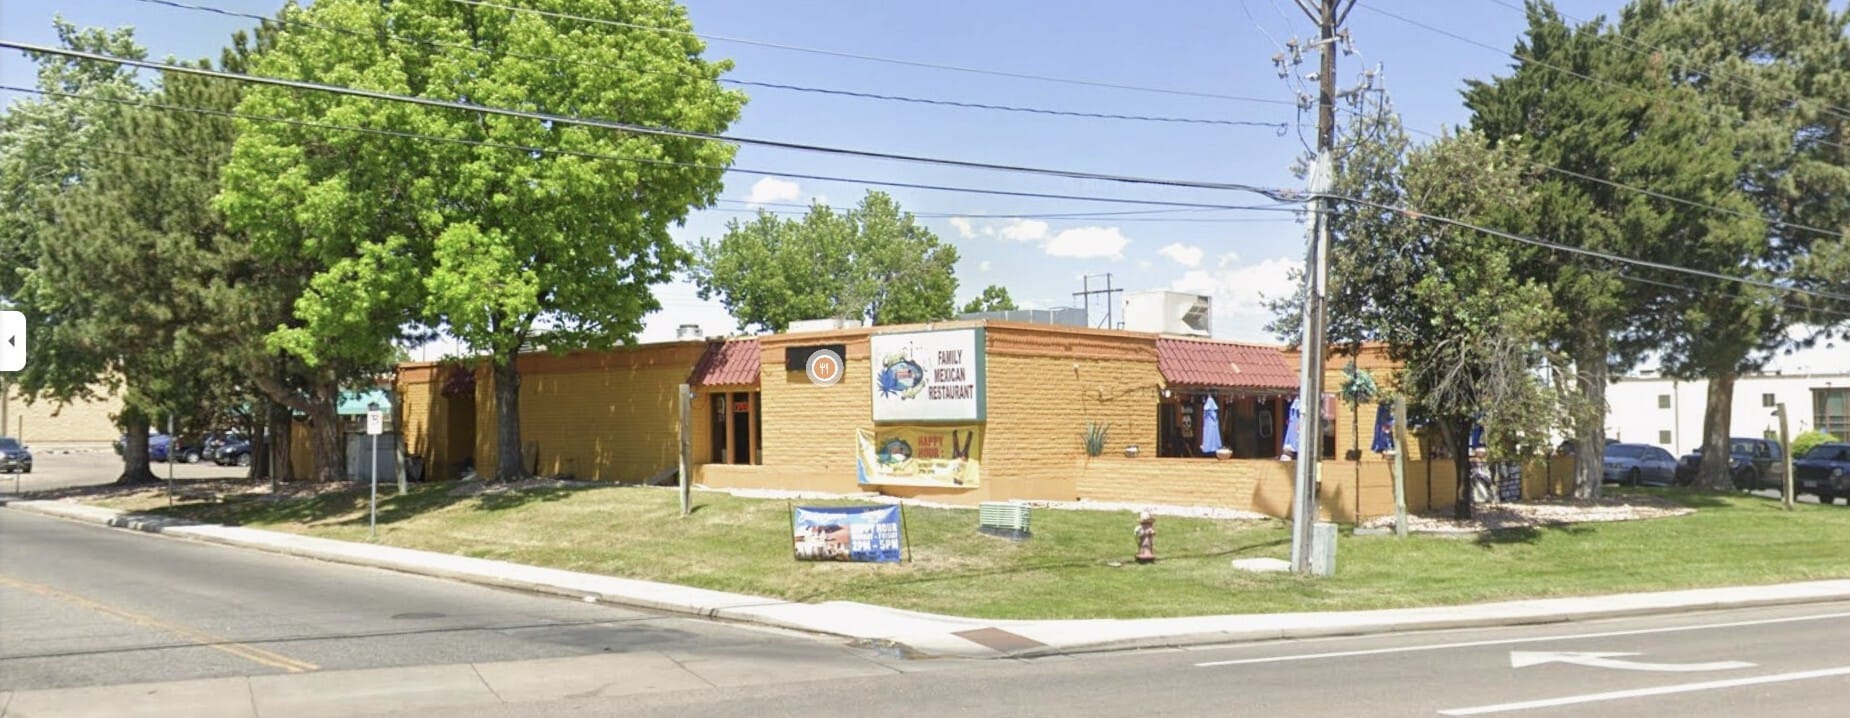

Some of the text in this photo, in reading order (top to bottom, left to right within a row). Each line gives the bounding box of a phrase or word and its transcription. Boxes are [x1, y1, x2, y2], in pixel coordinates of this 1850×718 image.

[938, 349, 962, 365] FAMILY
[934, 367, 966, 383] MEXICAN
[928, 384, 974, 400] RESTAURANT
[917, 435, 943, 447] HAPPY
[876, 523, 897, 532] HOUR
[852, 540, 871, 551] 2PM
[879, 539, 899, 550] 5PM
